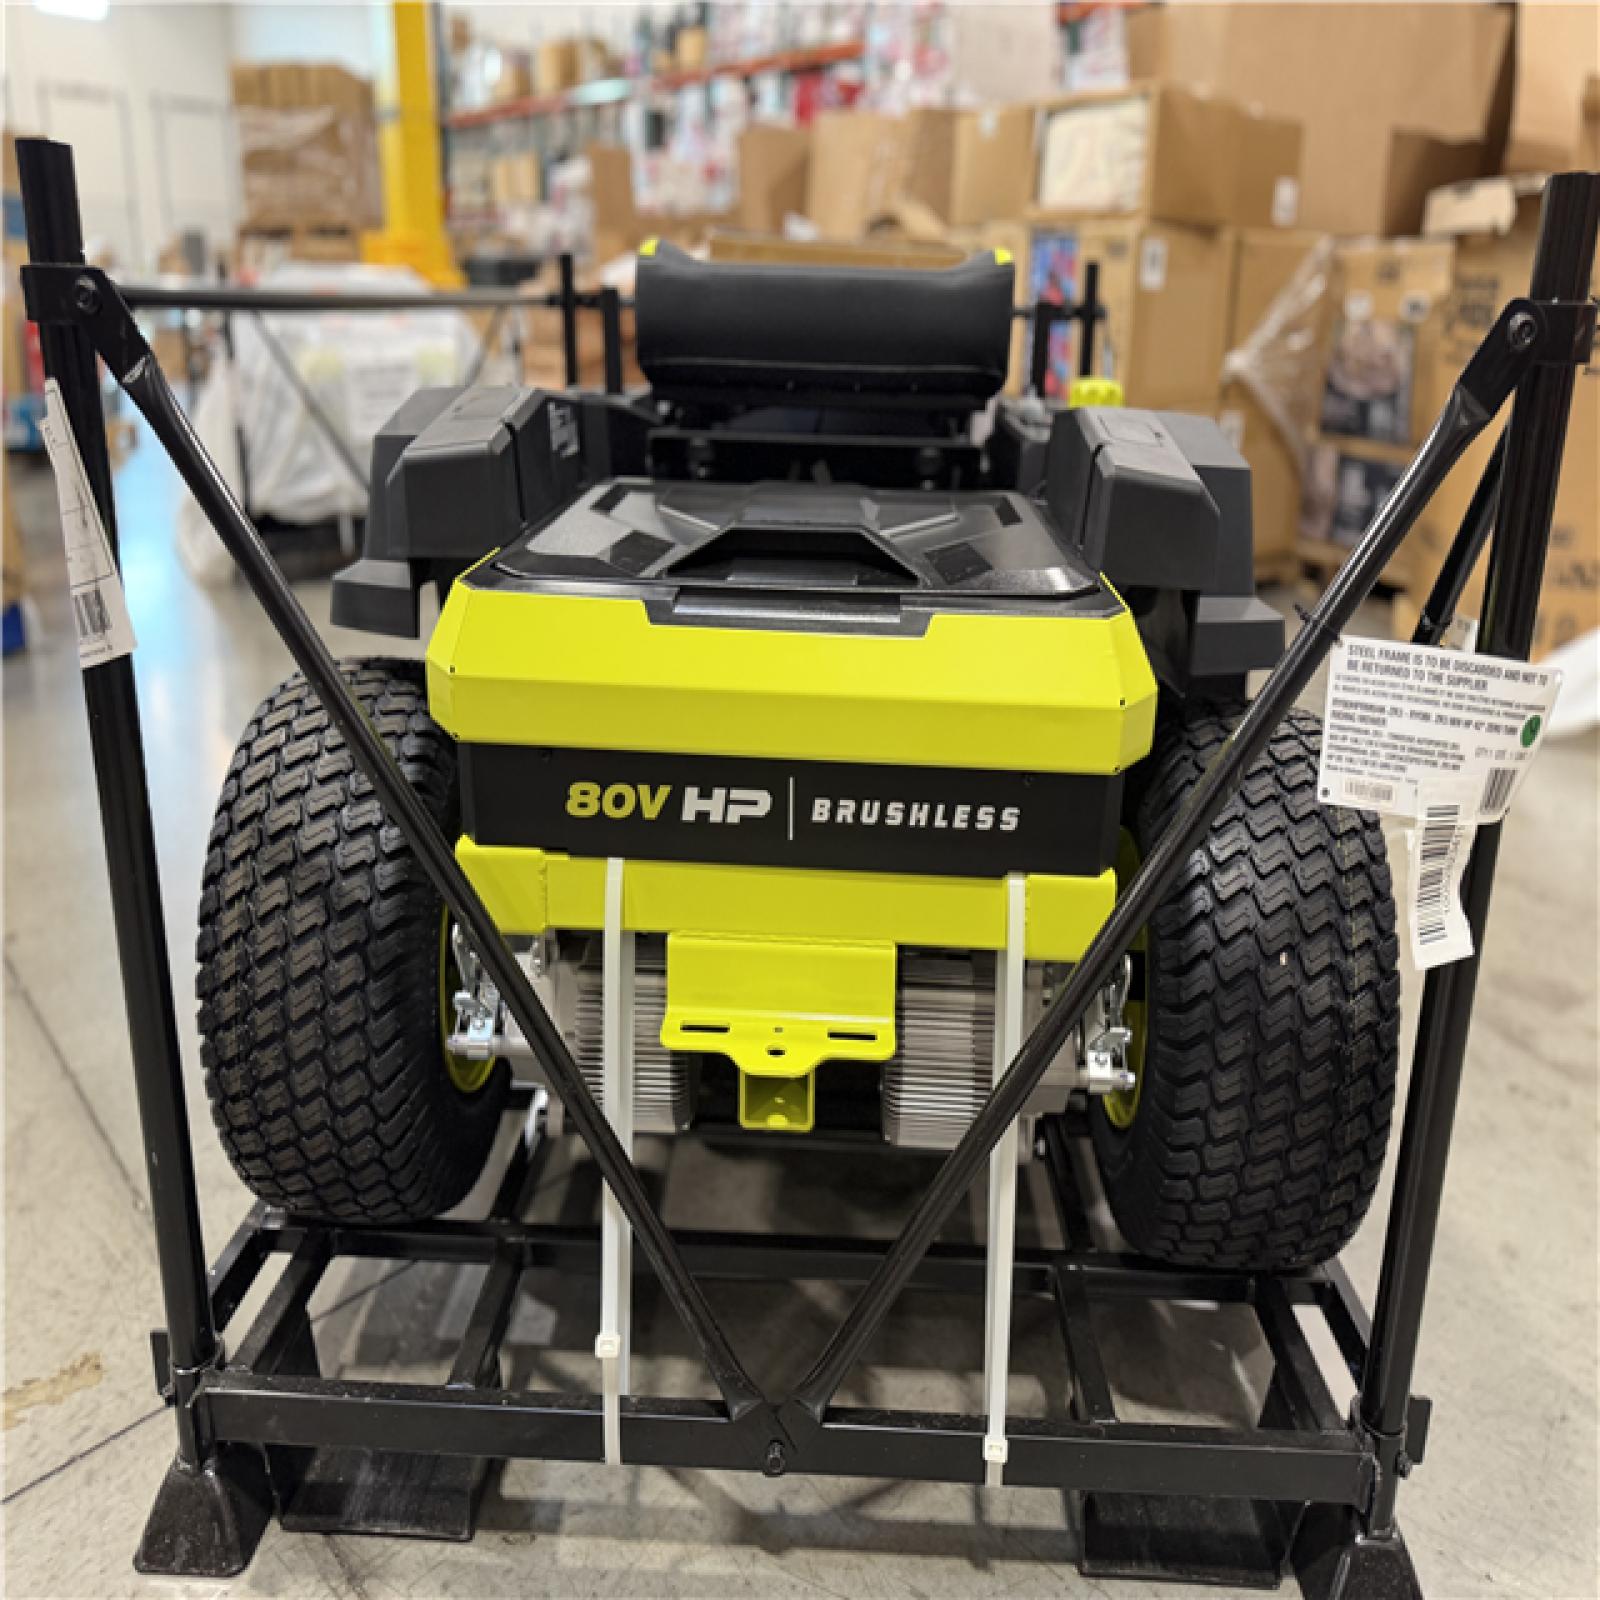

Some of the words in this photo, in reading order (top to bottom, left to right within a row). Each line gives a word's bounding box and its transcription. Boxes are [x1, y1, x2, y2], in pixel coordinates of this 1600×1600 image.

[1347, 659, 1359, 672] BE
[1361, 661, 1411, 679] RETURNED
[1413, 669, 1426, 682] TO
[1428, 670, 1444, 686] THE
[1446, 674, 1489, 691] SUPPLIER
[1348, 644, 1376, 659] STEEL
[1379, 648, 1411, 663] FRAME
[1413, 653, 1424, 666] IS
[1426, 655, 1438, 668] TO
[1440, 657, 1451, 671] BE
[1454, 659, 1504, 679] DISCARDED
[1505, 669, 1521, 682] AND
[1522, 671, 1537, 685] NOT
[1538, 674, 1549, 688] TO
[565, 781, 673, 821] 80V
[680, 786, 773, 824] HP
[811, 796, 1021, 832] BRUSHLESS
